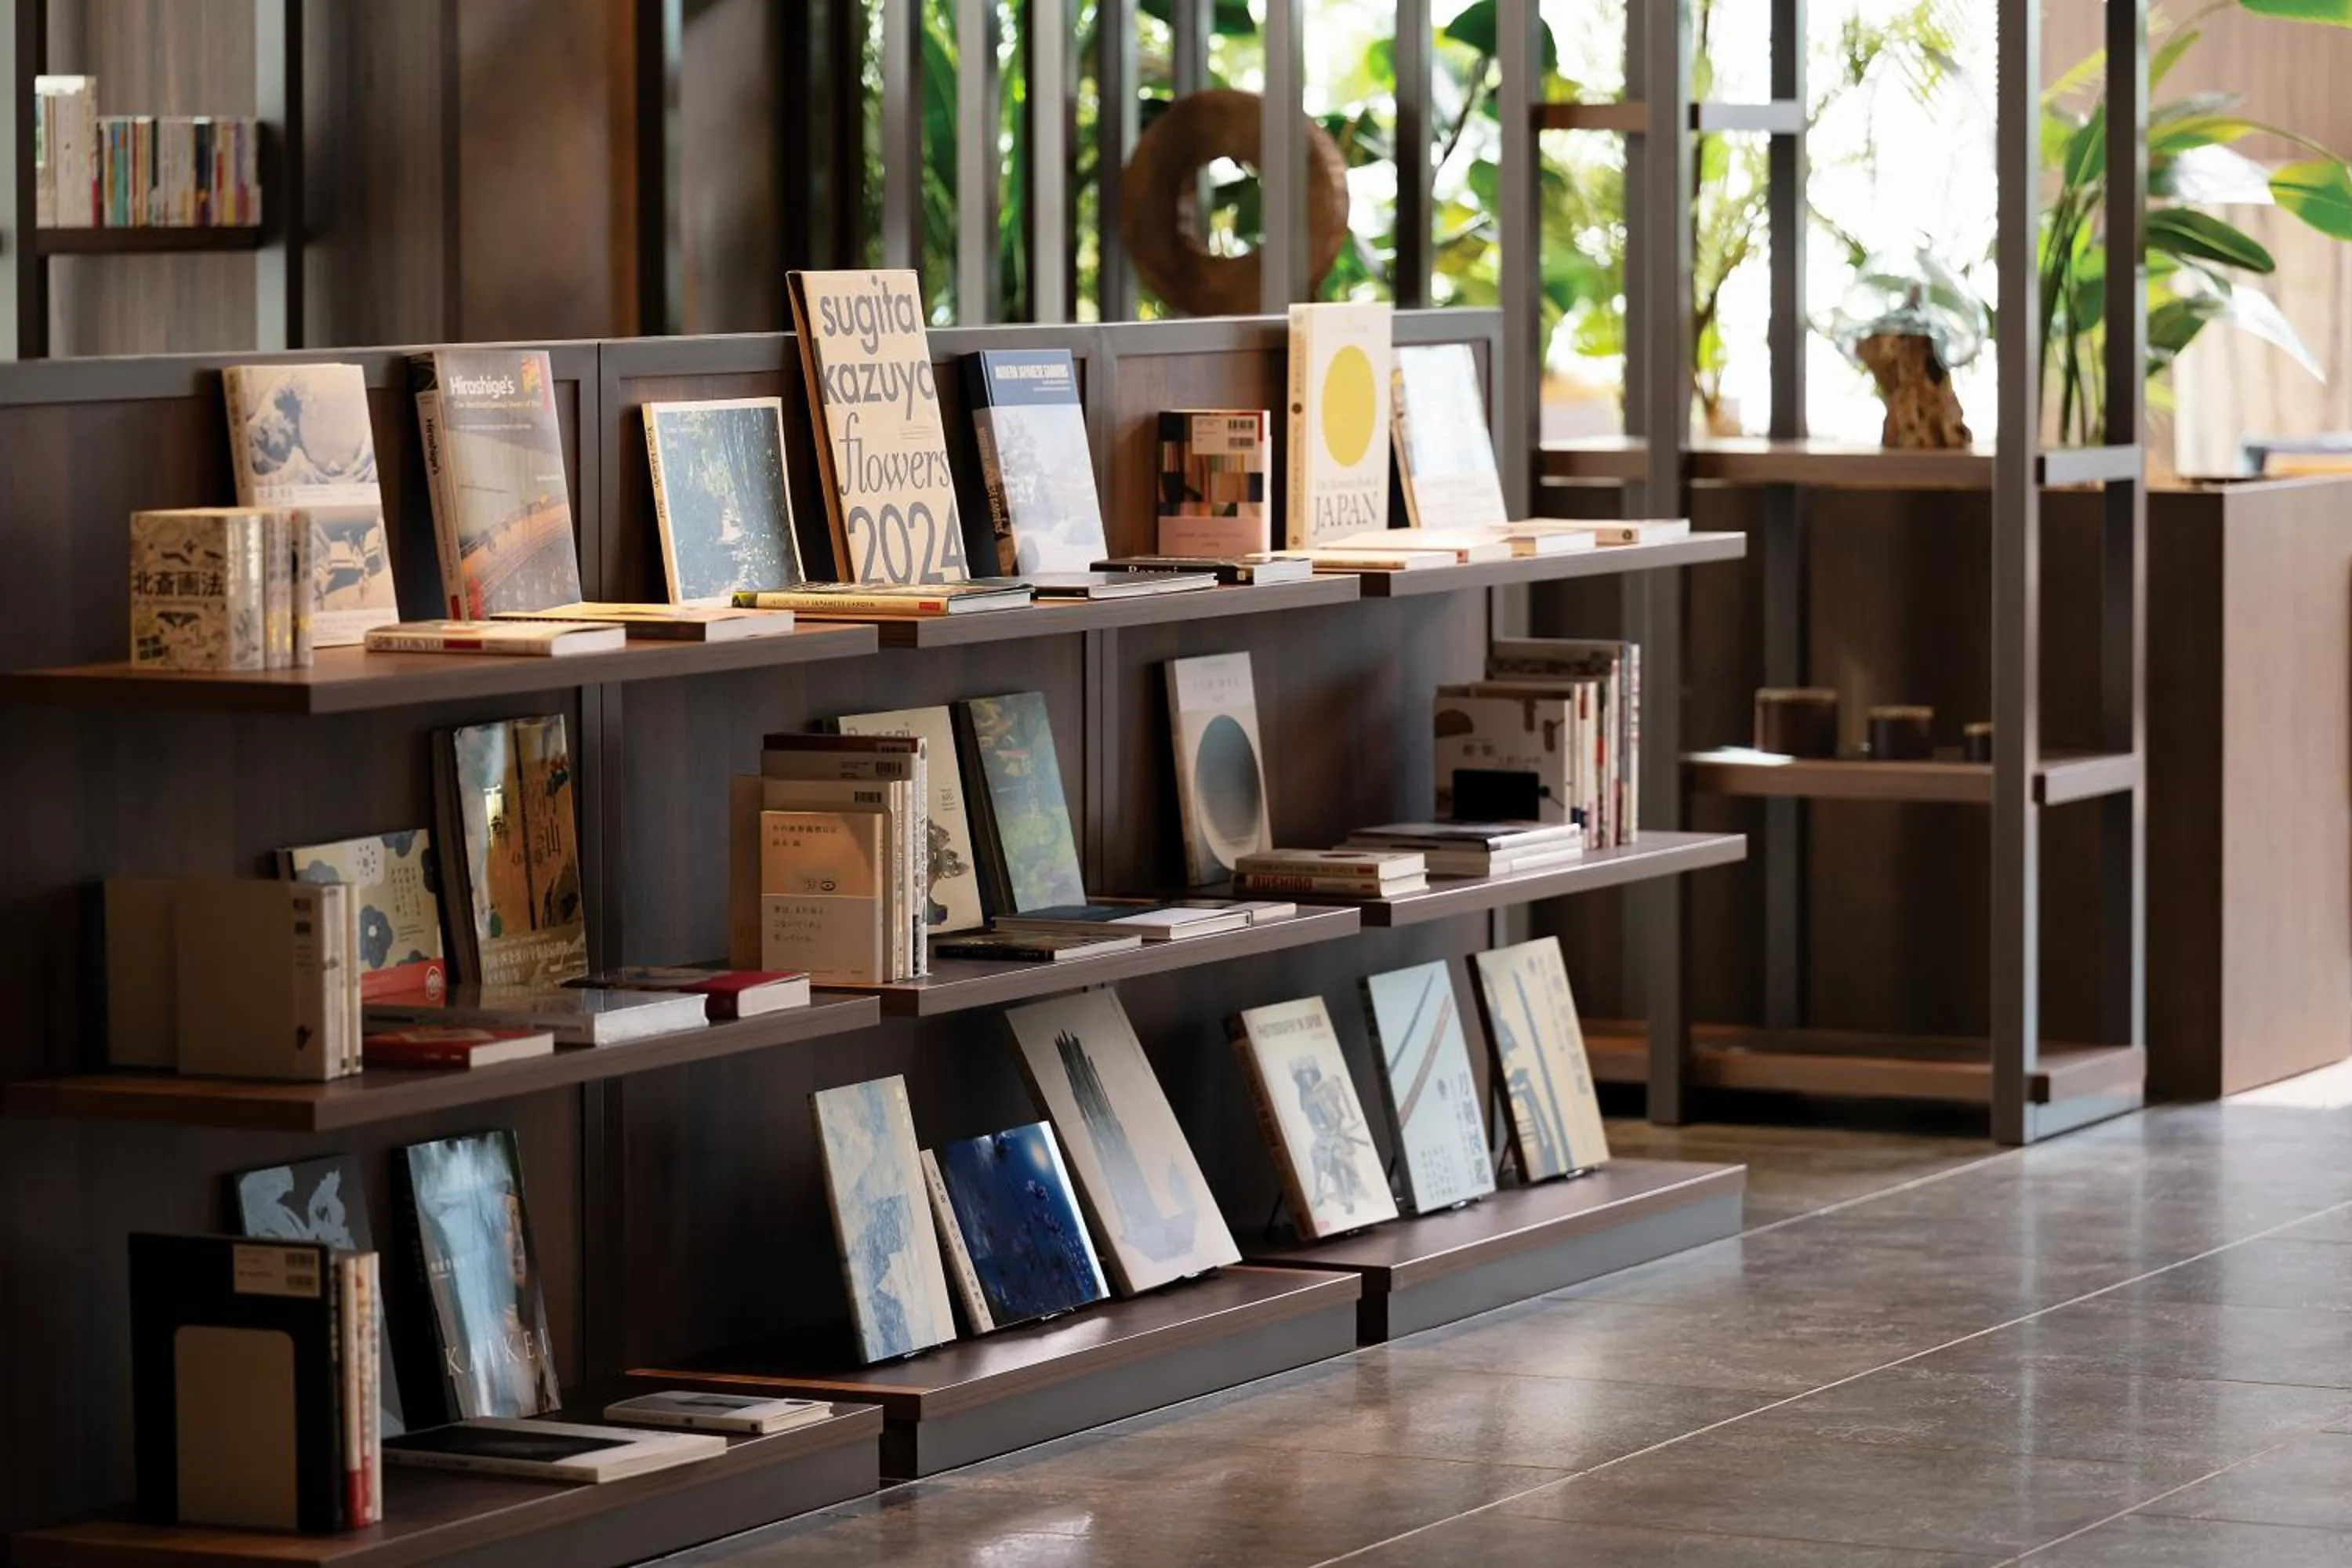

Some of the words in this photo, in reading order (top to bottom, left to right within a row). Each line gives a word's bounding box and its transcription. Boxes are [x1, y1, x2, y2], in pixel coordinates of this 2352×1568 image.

[819, 274, 916, 355] sugita
[449, 374, 516, 399] Hiroshige's
[426, 418, 441, 476] Hiroshige's
[838, 412, 951, 496] flowers
[1312, 490, 1378, 536] JAPAN
[848, 497, 971, 585] 2024
[131, 570, 224, 597] 北斎画法
[445, 1327, 549, 1375] KAIKEI
